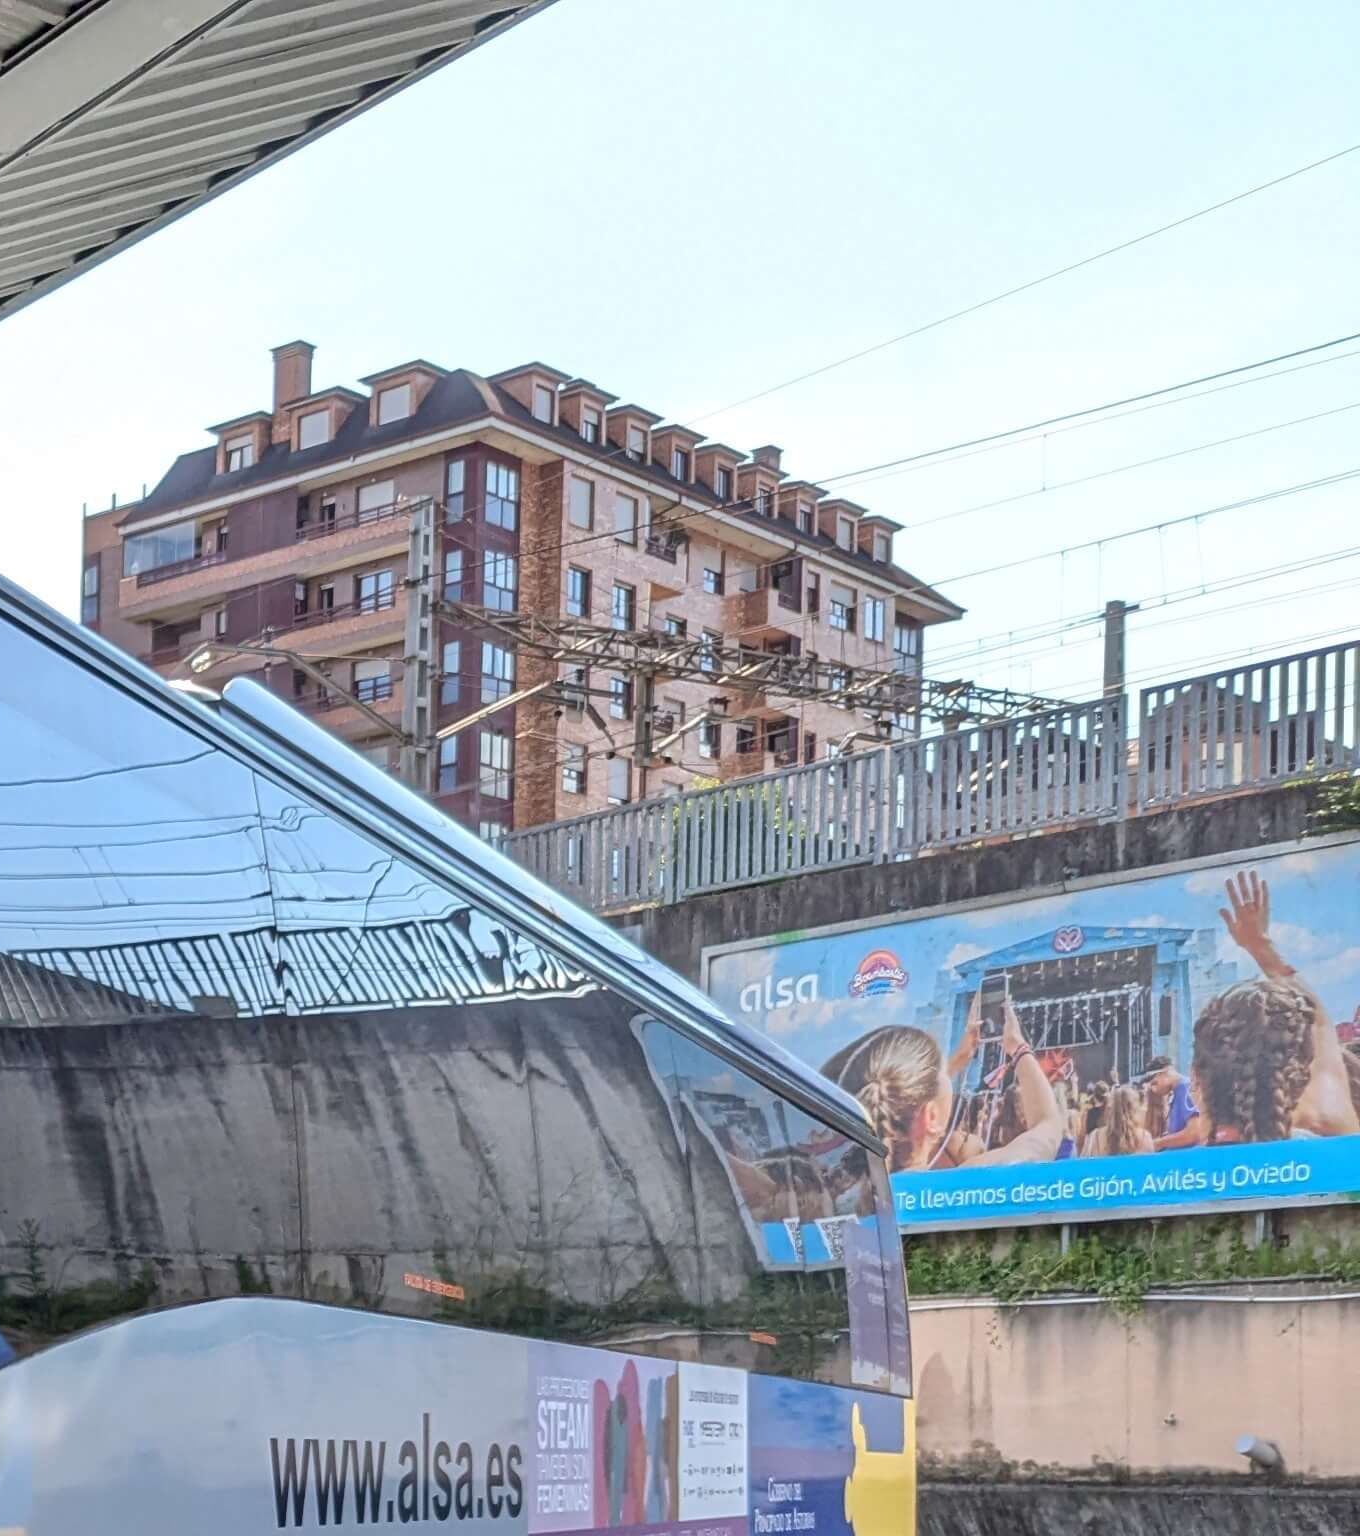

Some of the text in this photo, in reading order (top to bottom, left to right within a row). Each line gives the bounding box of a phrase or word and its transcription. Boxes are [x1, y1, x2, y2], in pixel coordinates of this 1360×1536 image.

[739, 973, 819, 1013] alsa
[895, 1162, 1312, 1210] Te llevamos desde Gijón, Avilés y Oviedo
[536, 1399, 590, 1450] STEAM
[269, 1412, 523, 1529] www.alsa.es
